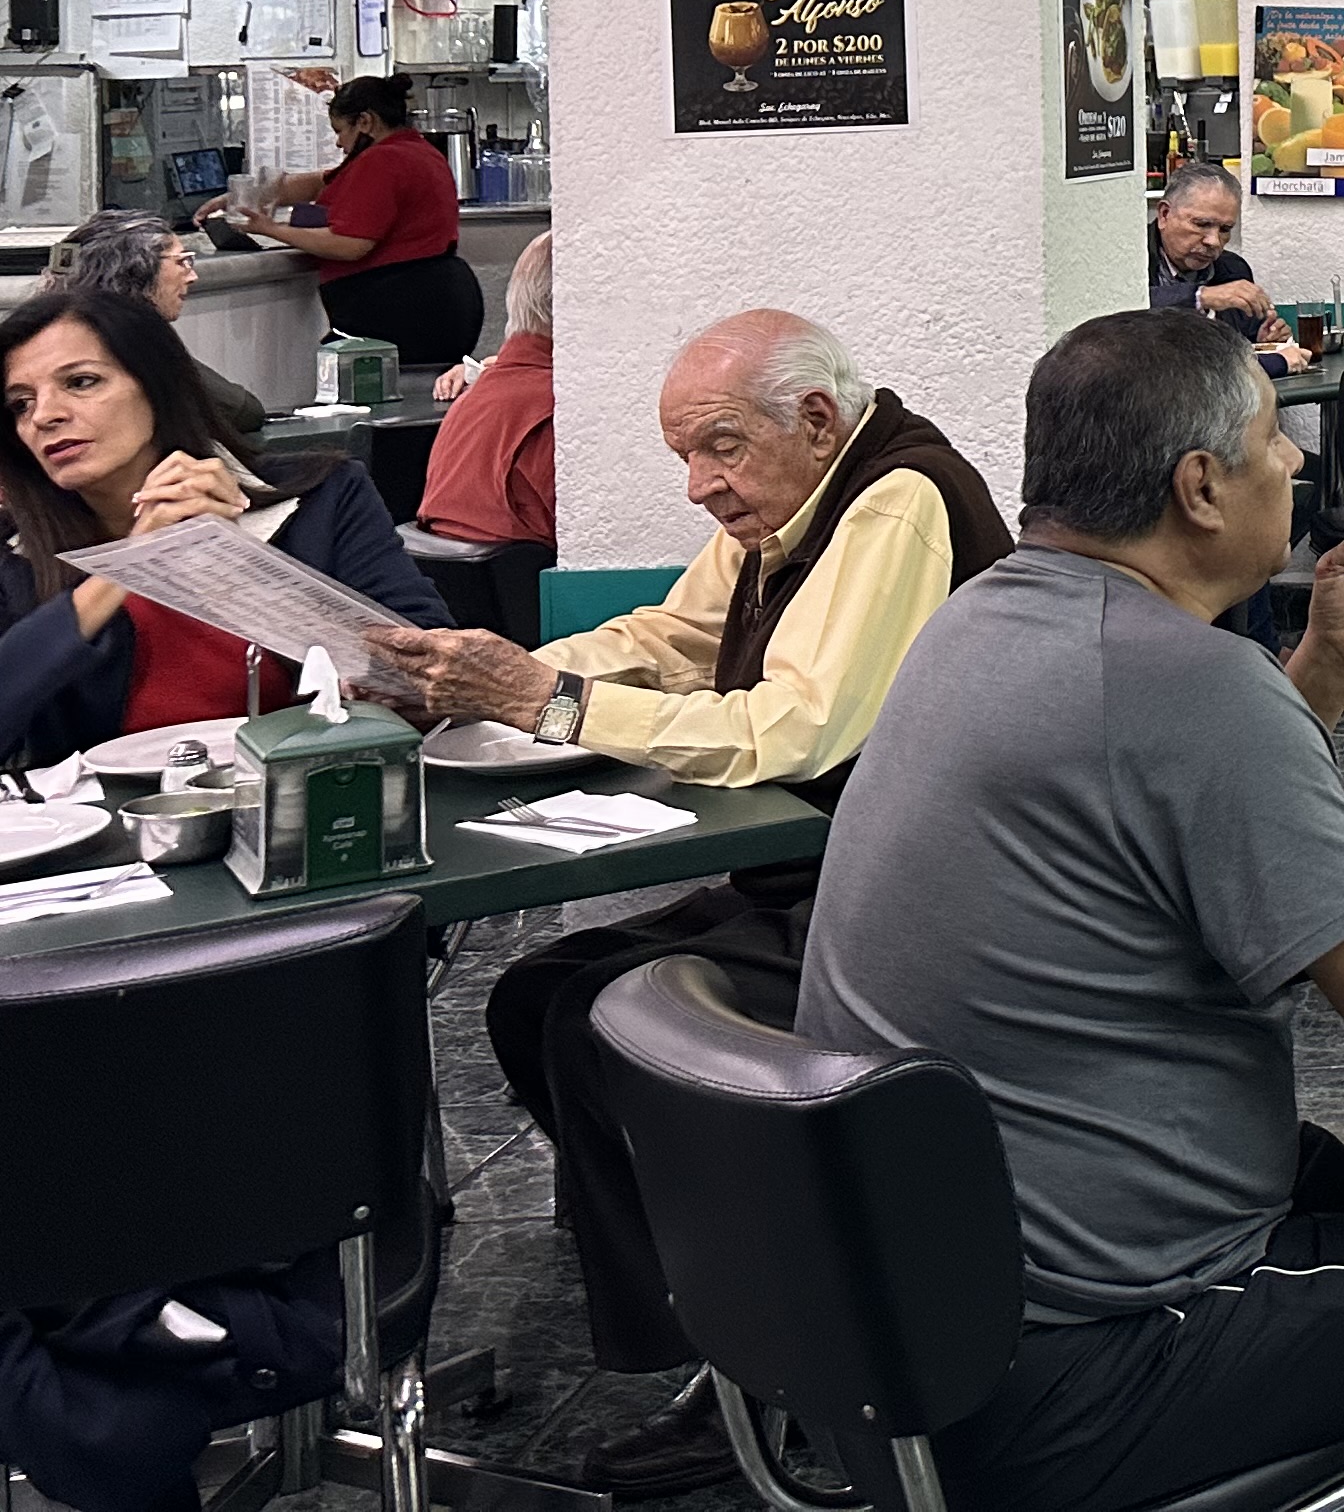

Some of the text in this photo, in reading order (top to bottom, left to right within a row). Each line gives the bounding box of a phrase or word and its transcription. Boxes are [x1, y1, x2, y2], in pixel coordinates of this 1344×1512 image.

[775, 34, 883, 55] 2 POR $200
[774, 54, 885, 68] DE LUNES A VIERNES
[1107, 115, 1126, 138] $120
[1272, 180, 1324, 193] Horchata
